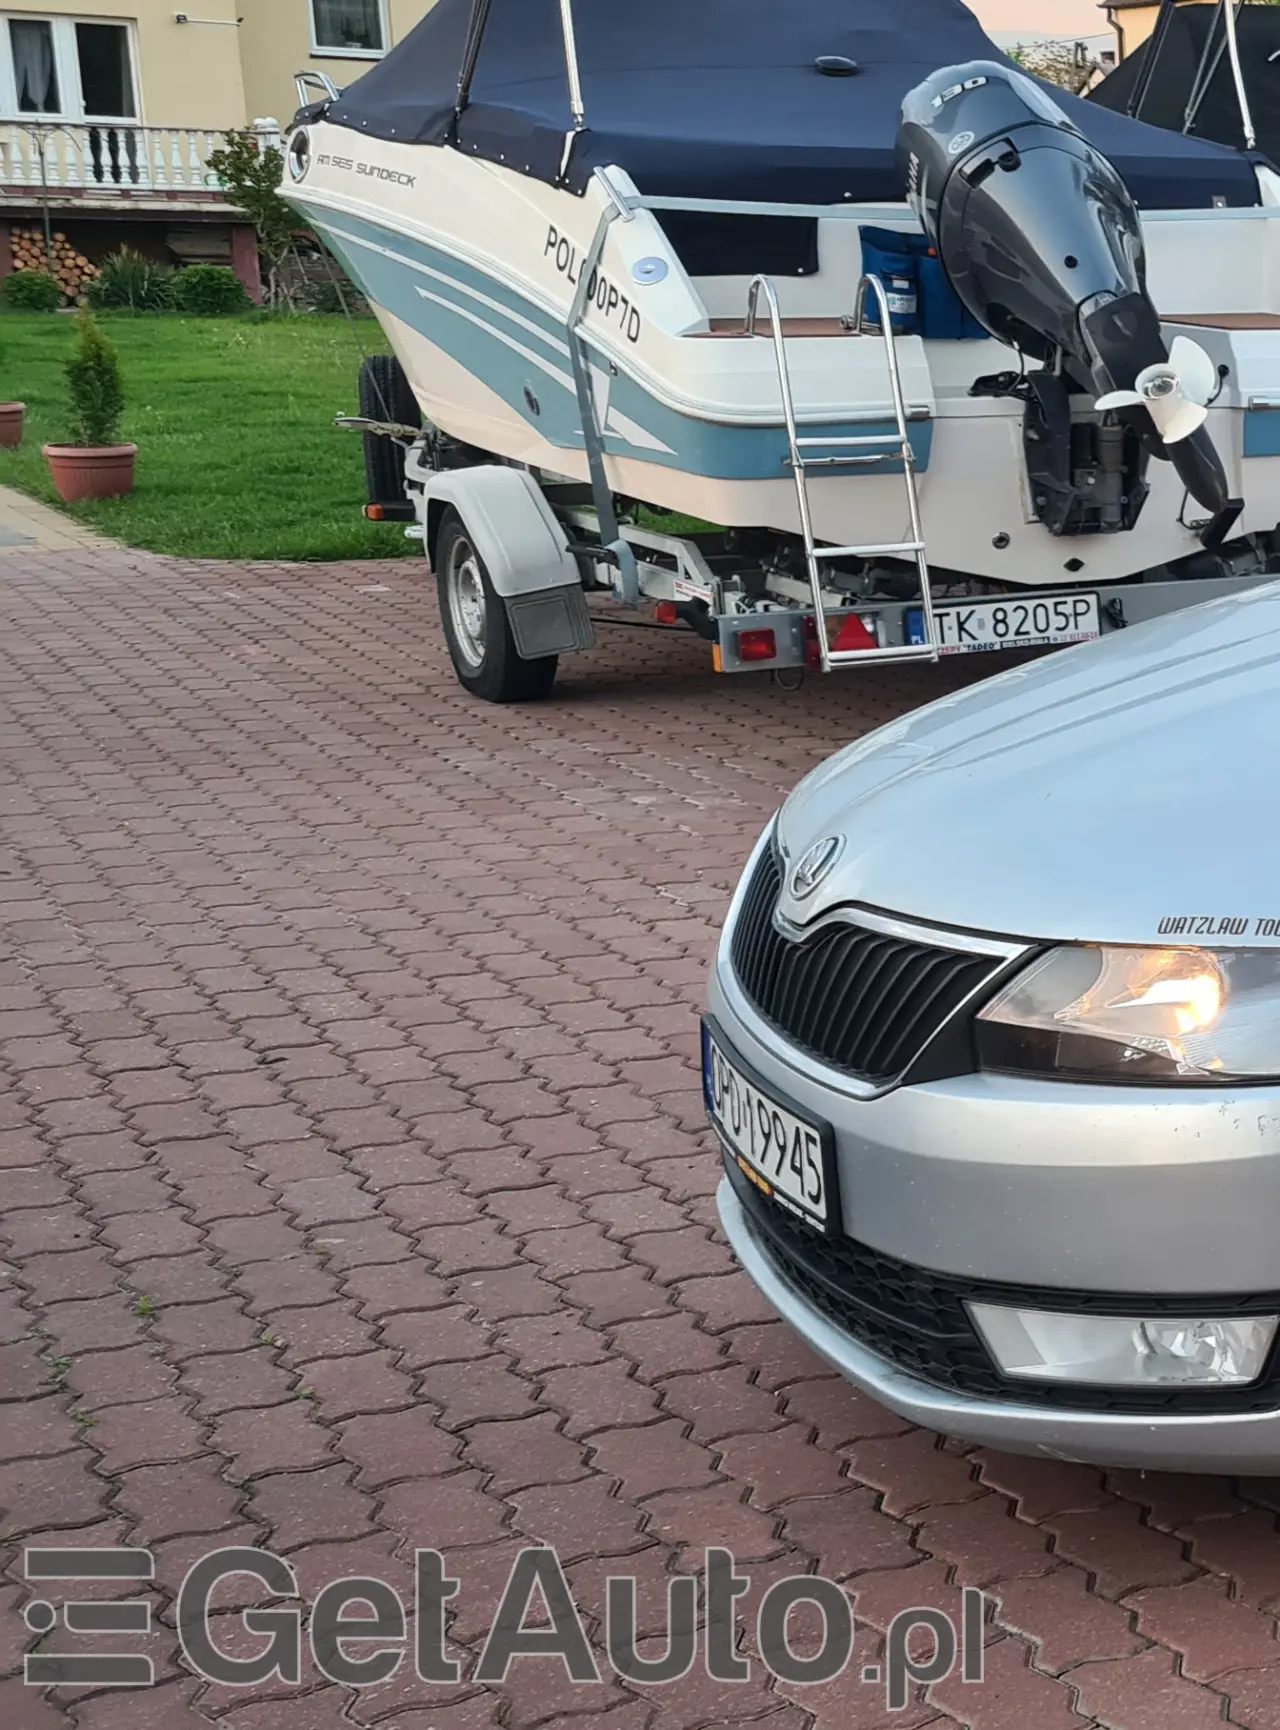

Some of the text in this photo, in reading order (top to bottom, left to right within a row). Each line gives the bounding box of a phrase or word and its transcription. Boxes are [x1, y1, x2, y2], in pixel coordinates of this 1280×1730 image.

[931, 76, 987, 109] 130
[356, 162, 417, 188] SUNDECK
[933, 599, 1091, 644] TK 8205P
[1157, 916, 1249, 935] WATZLAW
[745, 1086, 822, 1205] 19945
